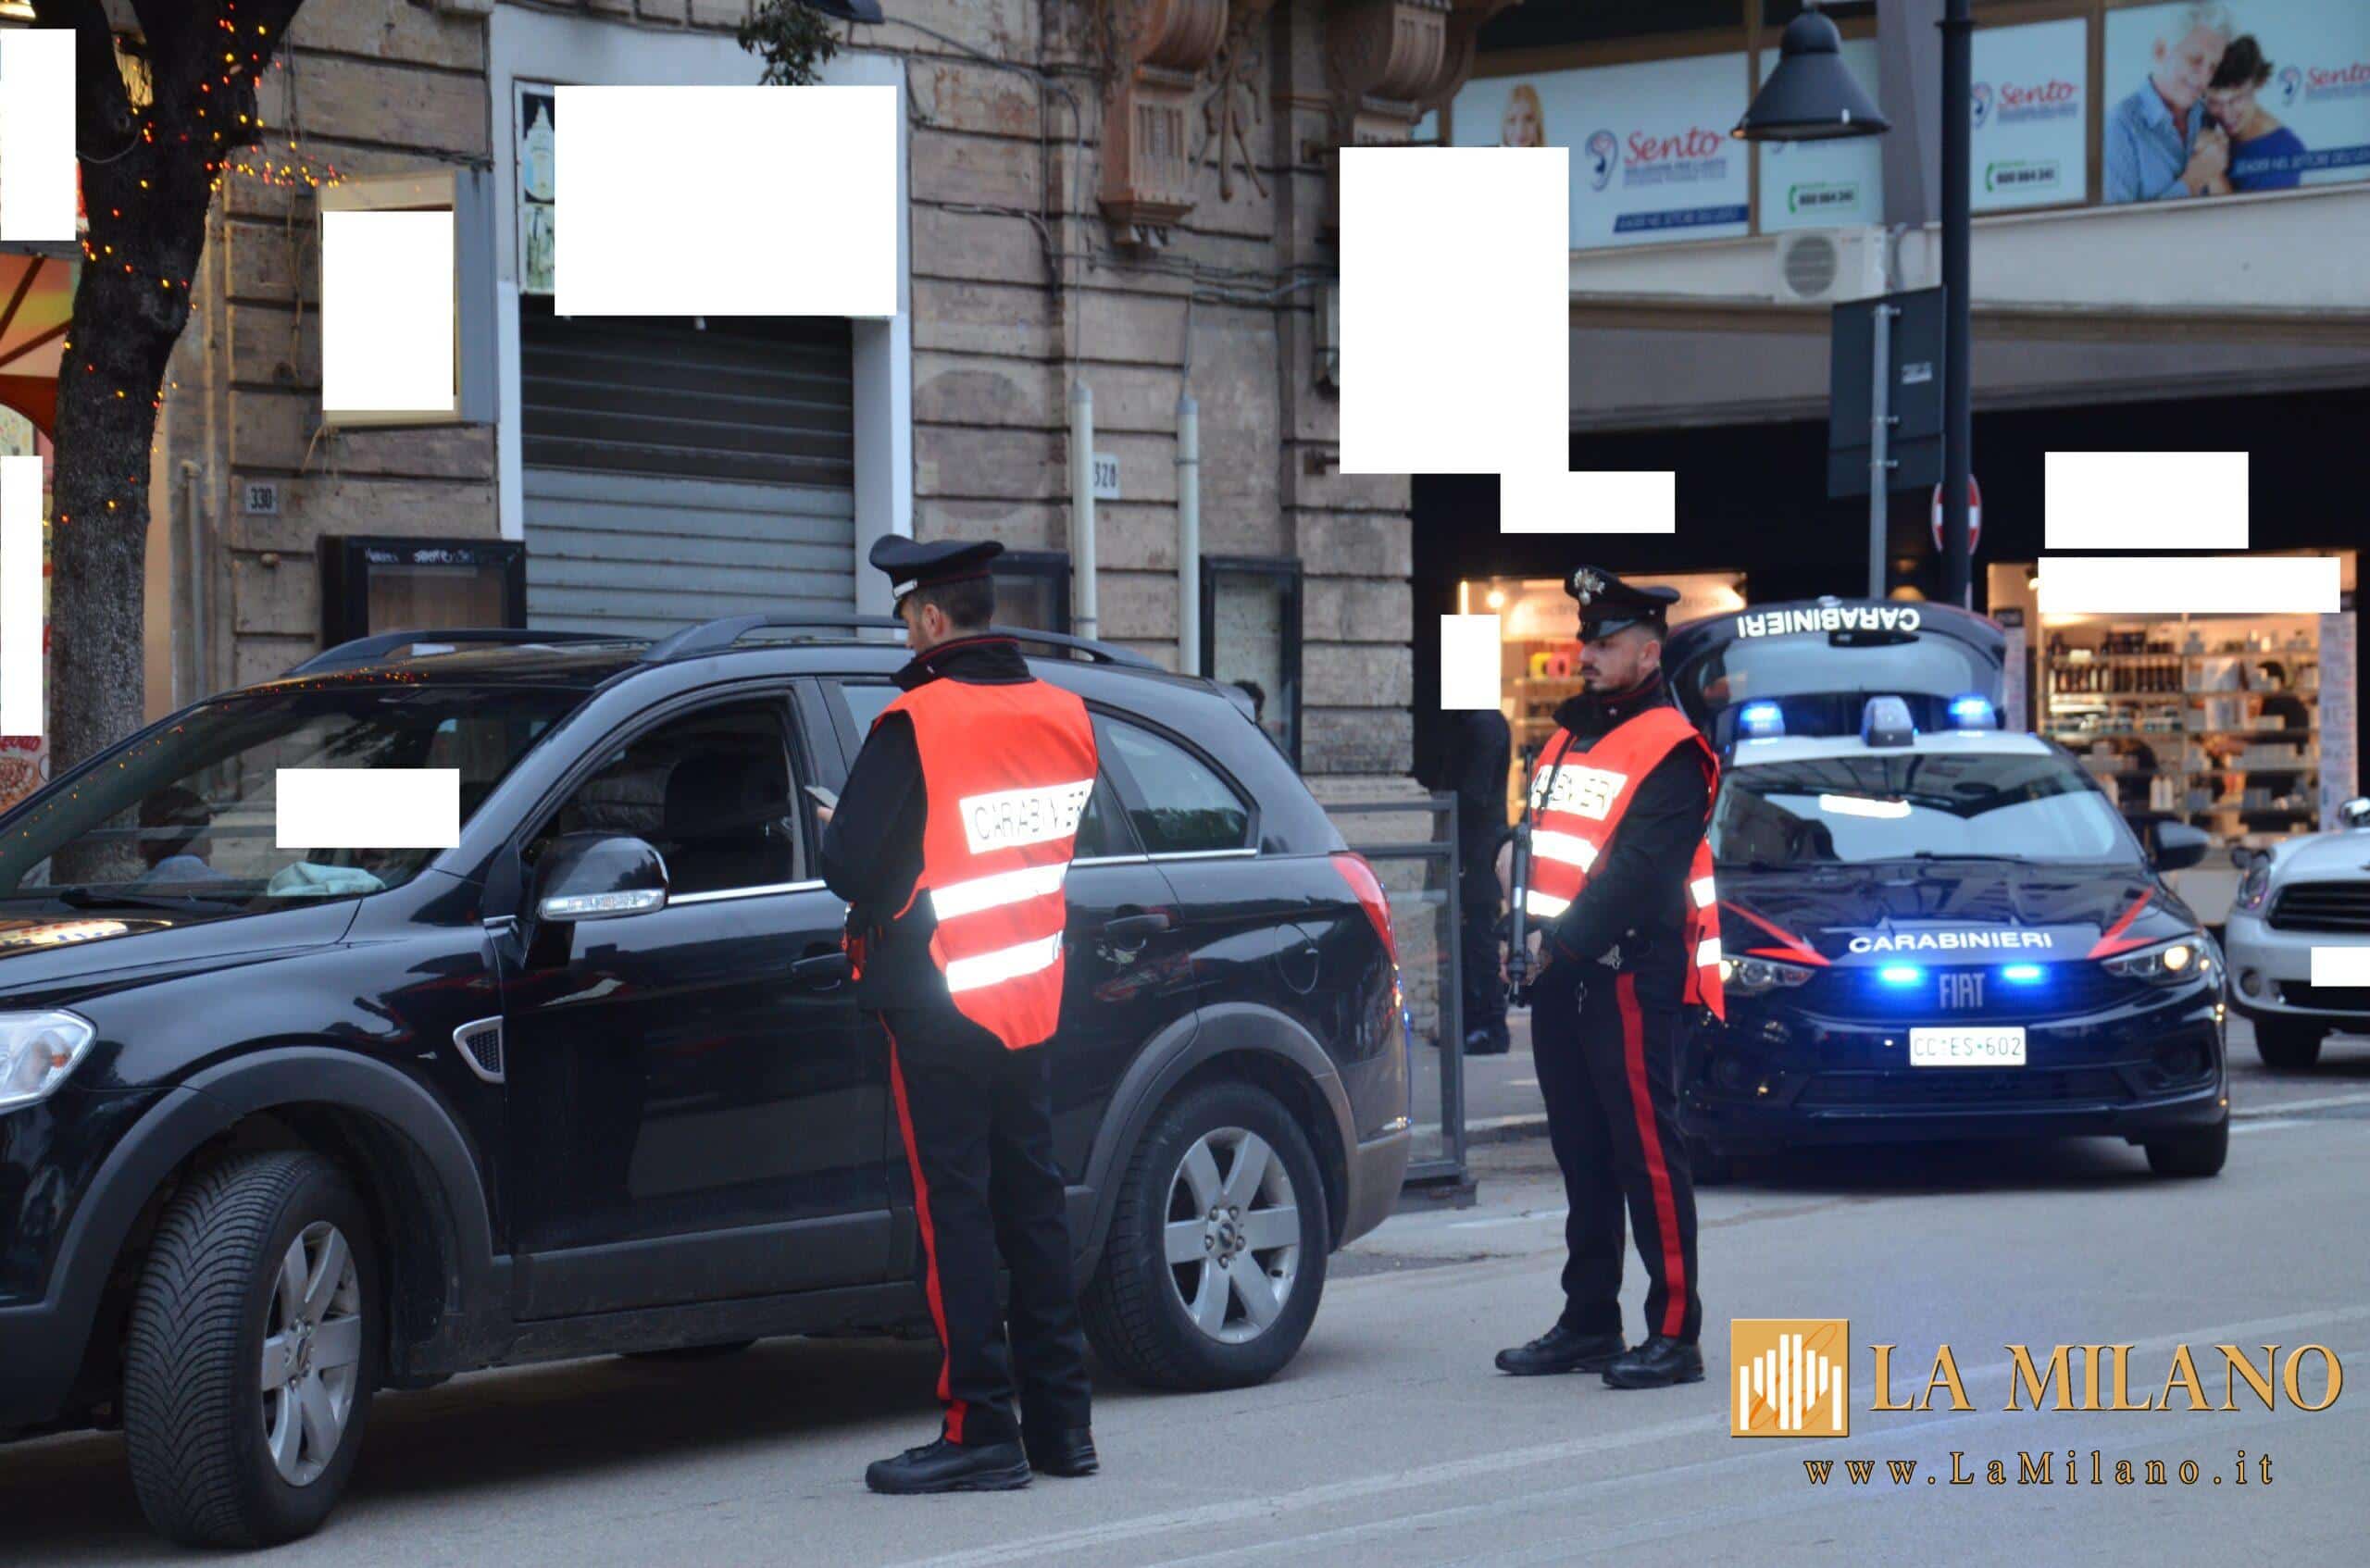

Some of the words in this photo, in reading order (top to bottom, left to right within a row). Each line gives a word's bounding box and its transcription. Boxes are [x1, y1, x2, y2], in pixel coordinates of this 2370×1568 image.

[2307, 62, 2370, 86] Sento
[1998, 79, 2079, 108] Sento
[1624, 126, 1725, 166] Sento
[251, 487, 272, 509] 330
[1737, 607, 1921, 638] CARABINIERI
[1849, 932, 2052, 953] CARABINIERI
[1940, 973, 1985, 1009] FIAT
